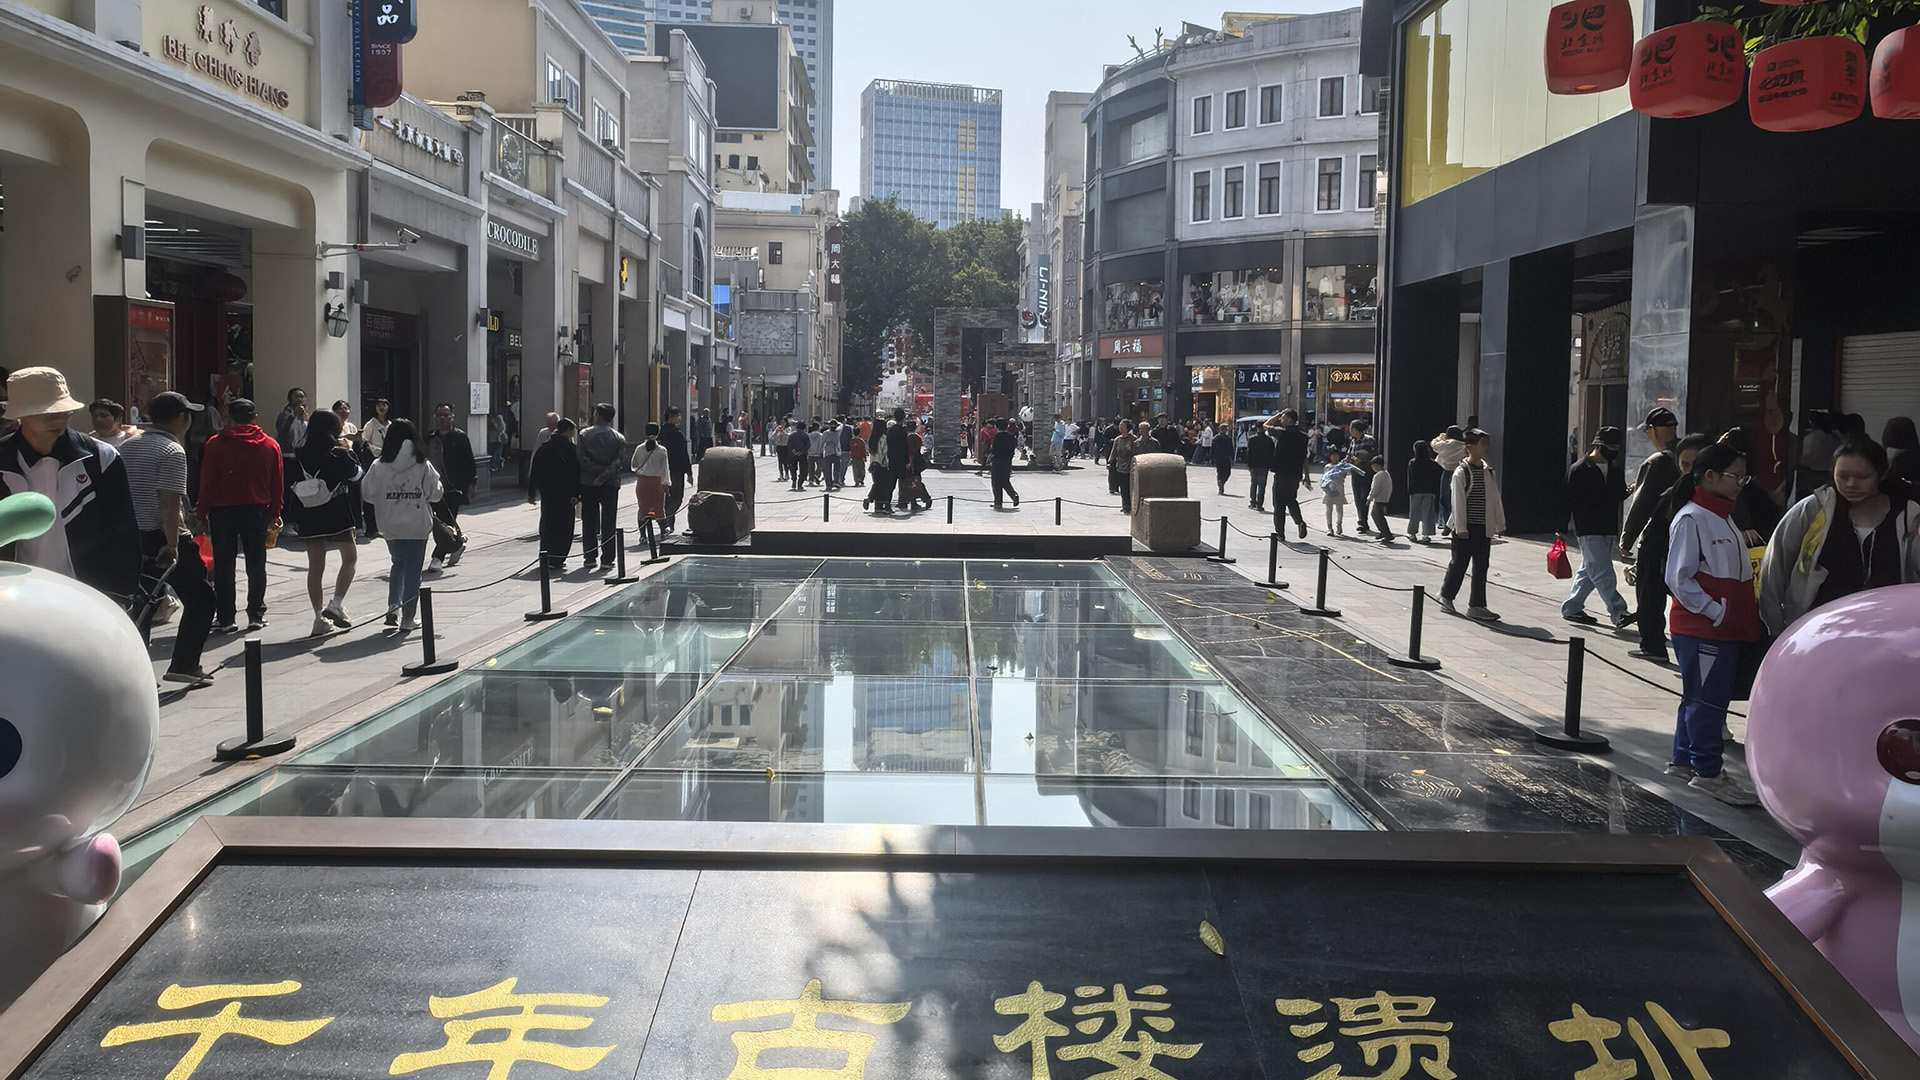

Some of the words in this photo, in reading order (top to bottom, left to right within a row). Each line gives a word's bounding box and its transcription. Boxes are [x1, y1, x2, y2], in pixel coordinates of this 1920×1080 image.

[487, 221, 538, 254] CROCODILE
[830, 243, 841, 285] 周大福
[1113, 339, 1142, 354] 周六福
[1125, 370, 1150, 379] 周六福
